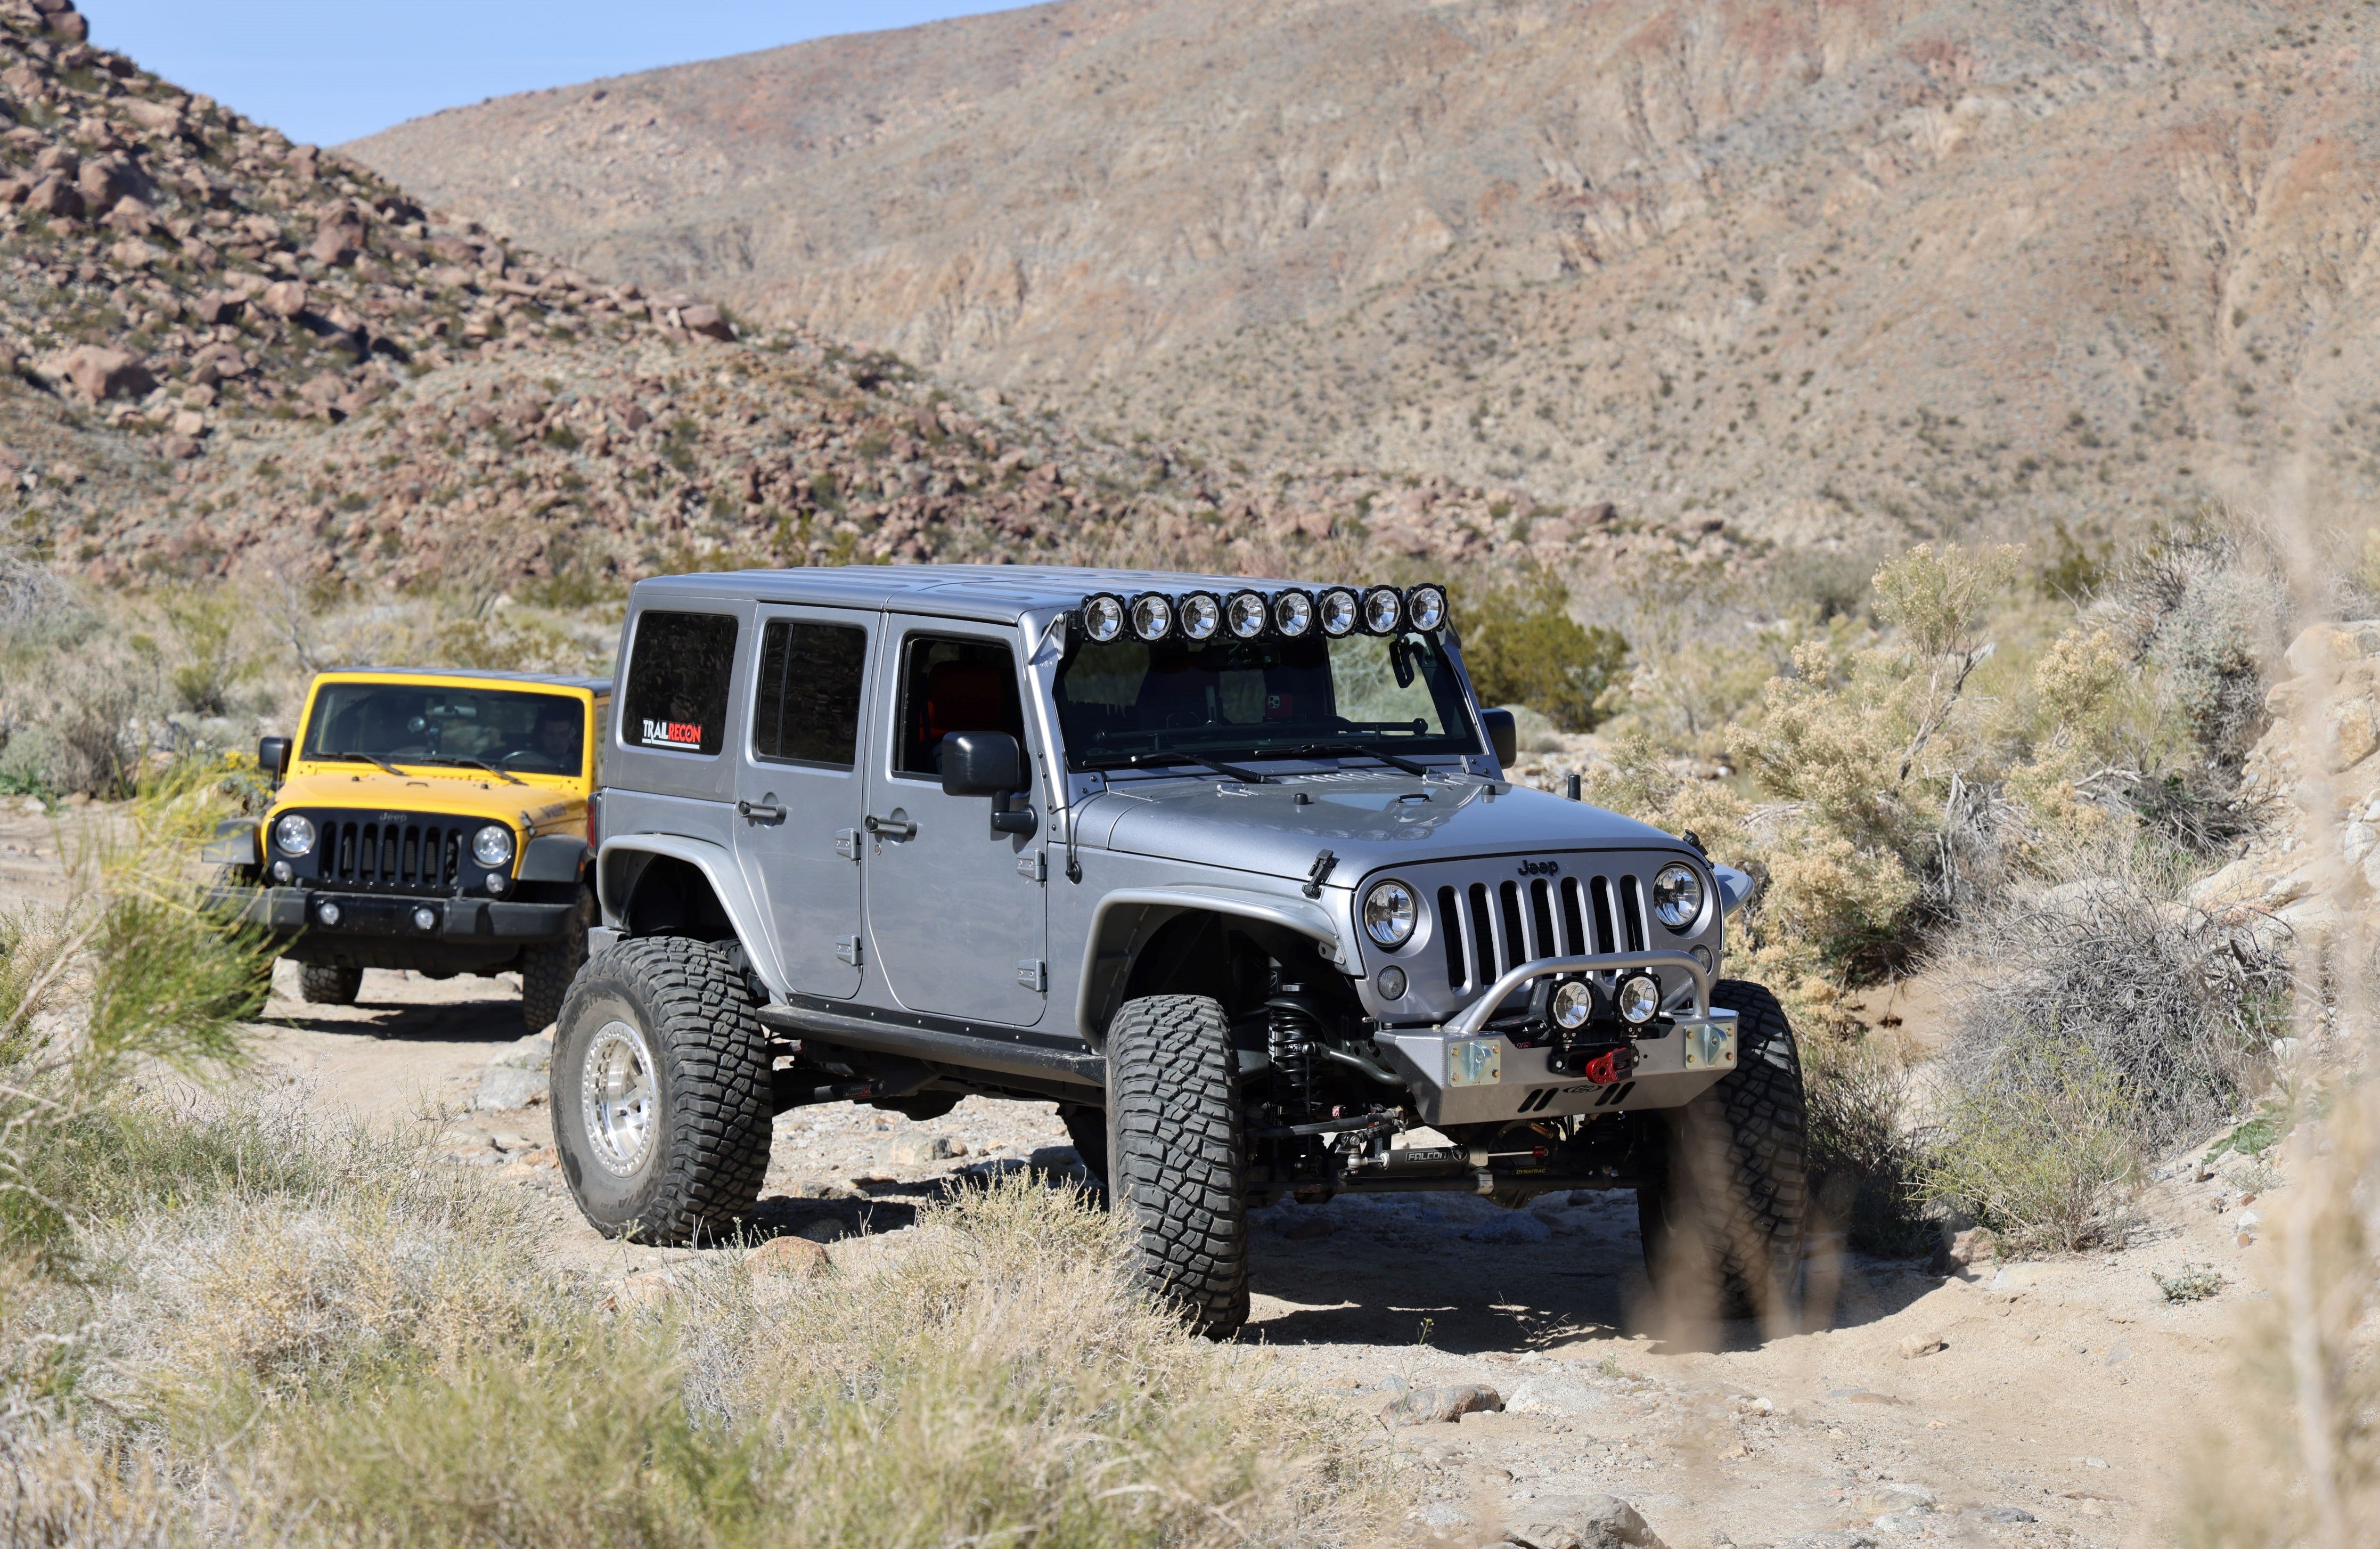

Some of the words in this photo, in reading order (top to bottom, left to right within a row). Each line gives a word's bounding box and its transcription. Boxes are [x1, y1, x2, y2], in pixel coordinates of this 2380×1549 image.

[643, 719, 702, 744] TRAILRECON
[379, 811, 407, 823] Jeep
[1517, 859, 1559, 877] Jeep
[1408, 1152, 1447, 1162] FALCON
